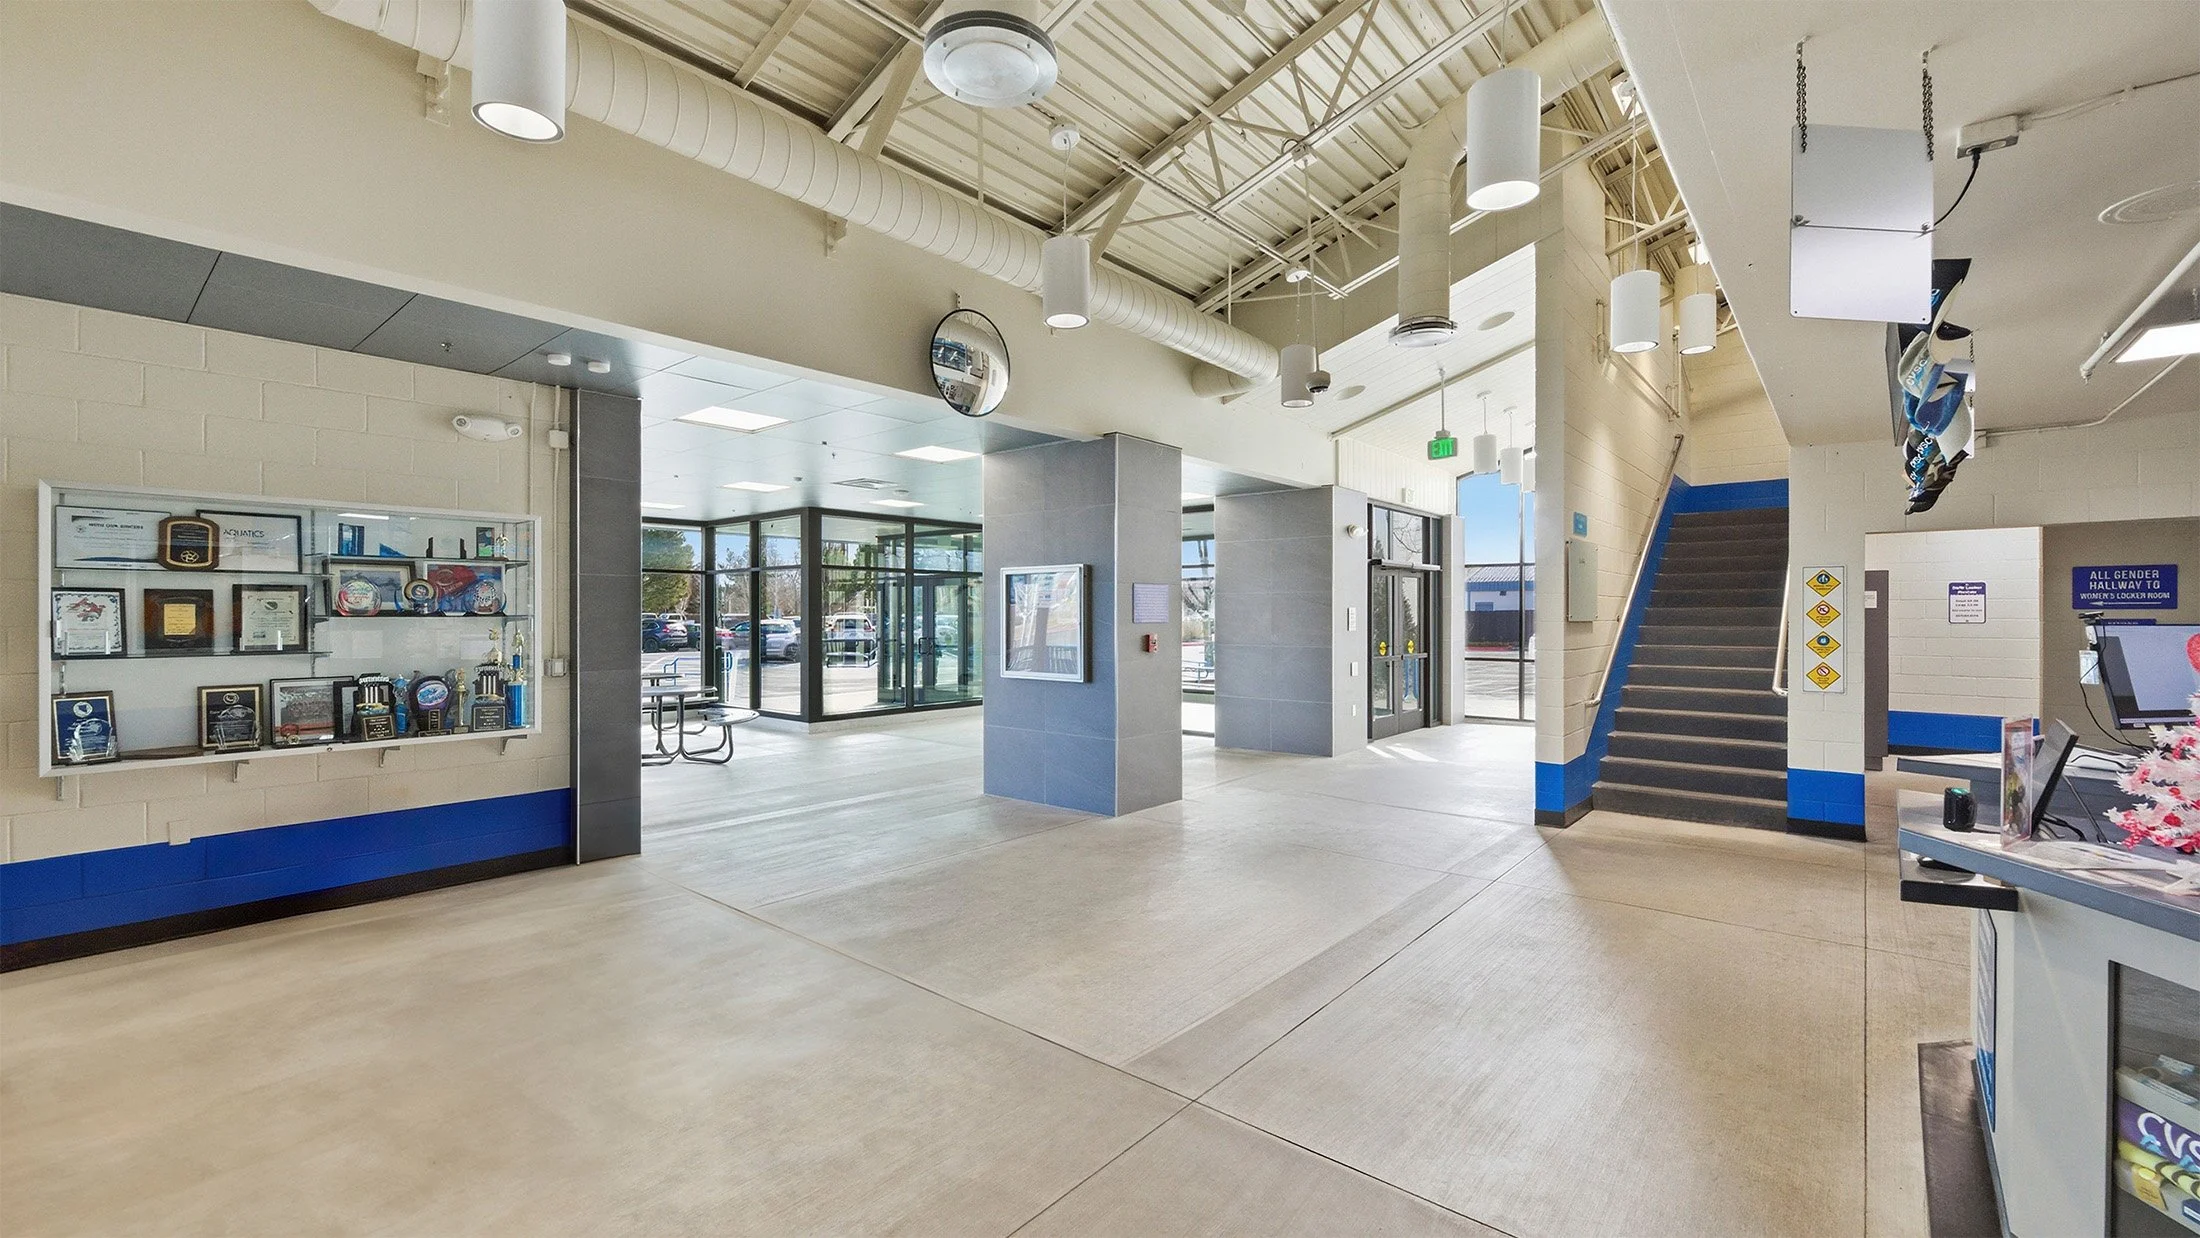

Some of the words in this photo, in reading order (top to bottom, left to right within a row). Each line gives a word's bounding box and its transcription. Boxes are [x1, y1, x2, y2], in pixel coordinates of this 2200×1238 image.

[1432, 441, 1452, 457] EXIT
[223, 529, 265, 538] AQUATICS
[2090, 571, 2110, 580] ALL
[2114, 570, 2159, 579] GENDER
[2089, 581, 2142, 590] HALLWAY
[2146, 580, 2160, 589] TO
[2116, 592, 2146, 600] LOCKER
